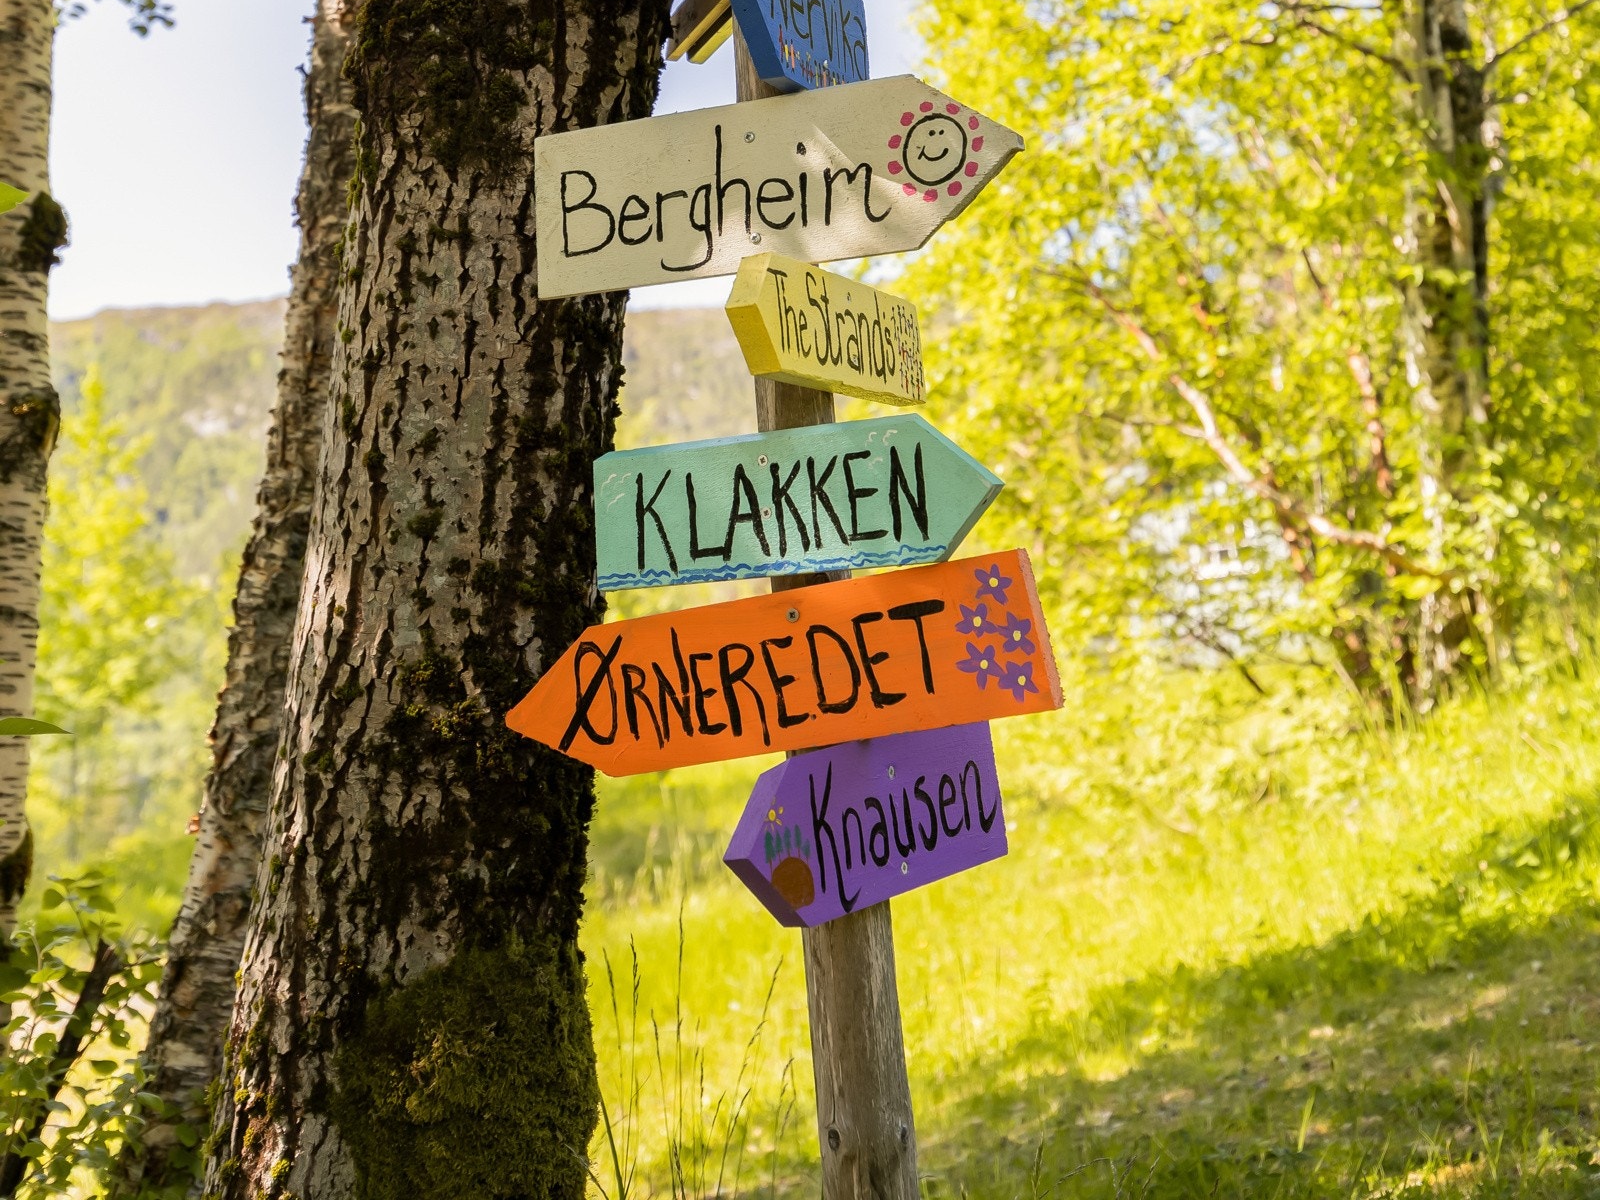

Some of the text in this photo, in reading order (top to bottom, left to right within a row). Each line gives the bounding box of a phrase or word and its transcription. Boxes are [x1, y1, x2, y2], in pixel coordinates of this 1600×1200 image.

[561, 124, 892, 272] Bergheim
[636, 442, 930, 574] KLAKKEN
[558, 599, 945, 752] ØRNEREDET
[808, 760, 998, 914] Knausen
